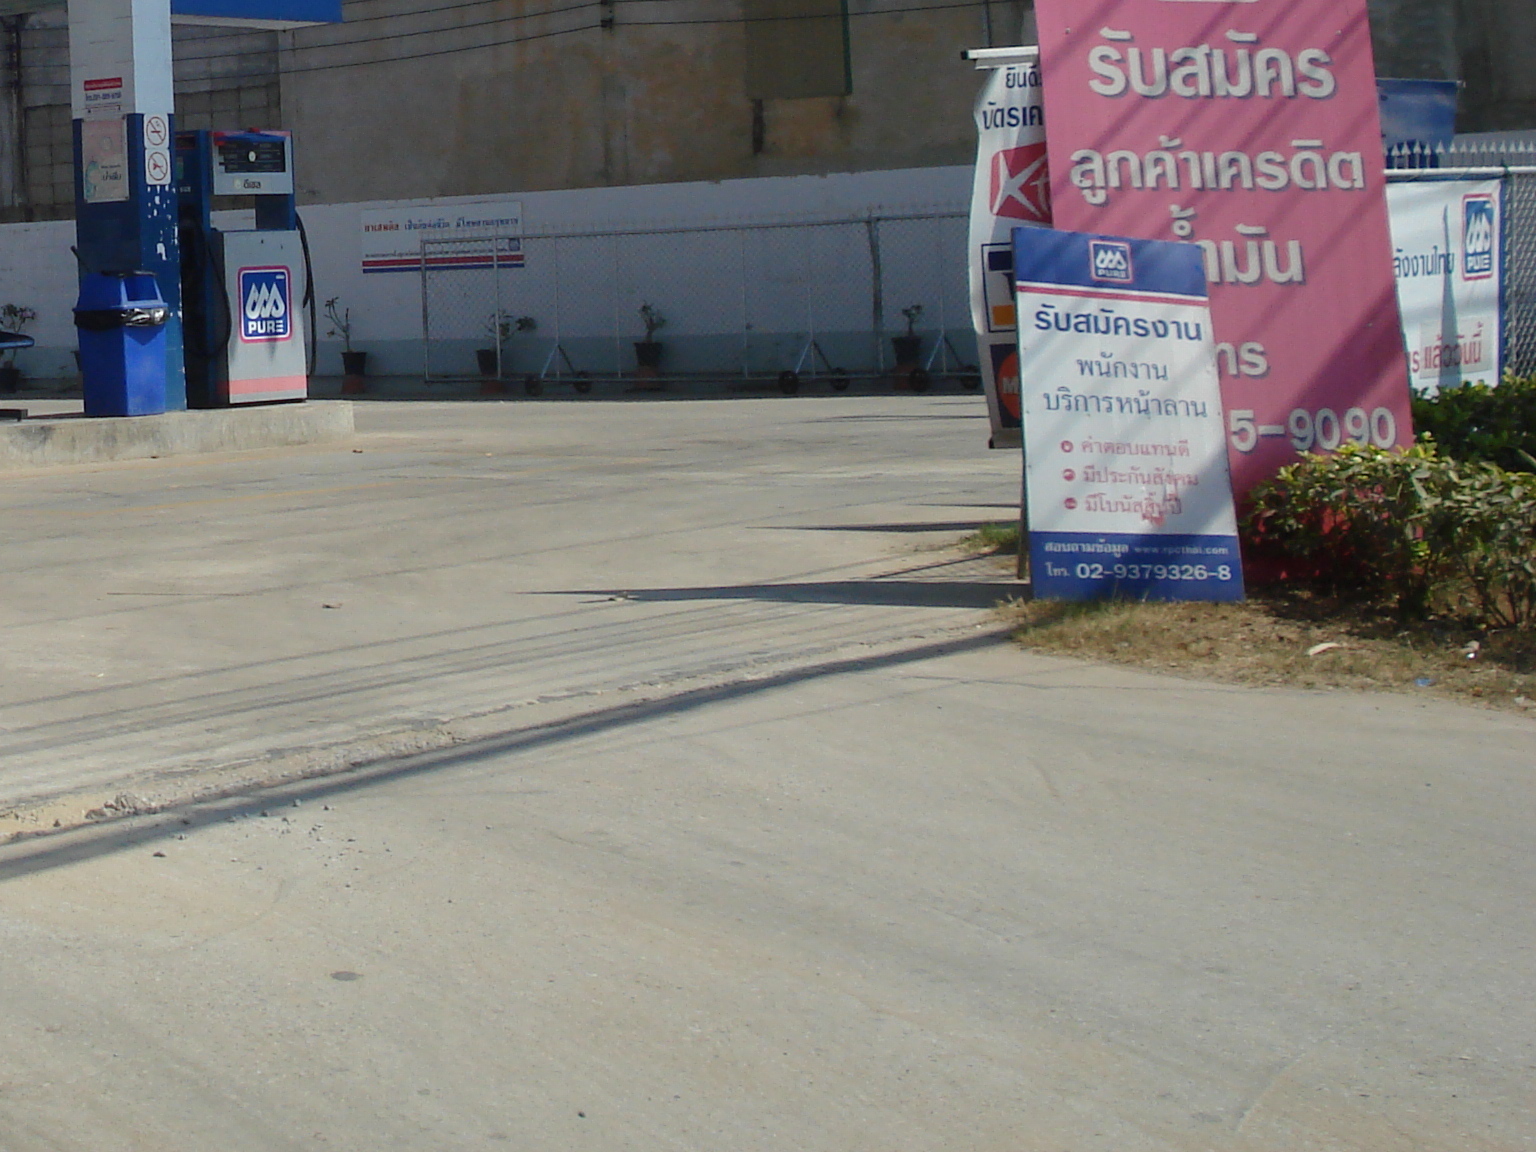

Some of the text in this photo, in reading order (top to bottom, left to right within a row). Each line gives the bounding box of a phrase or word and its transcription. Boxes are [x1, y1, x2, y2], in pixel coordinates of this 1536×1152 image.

[1005, 64, 1043, 89] ยินดี
[1088, 26, 1336, 98] รับสมัคร
[982, 100, 1044, 130] บัตรเค
[1069, 135, 1364, 205] ลูกค้าเครดิต
[247, 319, 284, 334] PURE
[1034, 303, 1203, 341] รับสมัครงาน
[1076, 351, 1169, 380] พนักงาน
[1043, 386, 1208, 418] บริการหน้าลาน
[1076, 563, 1232, 580] 02-9379326-8
